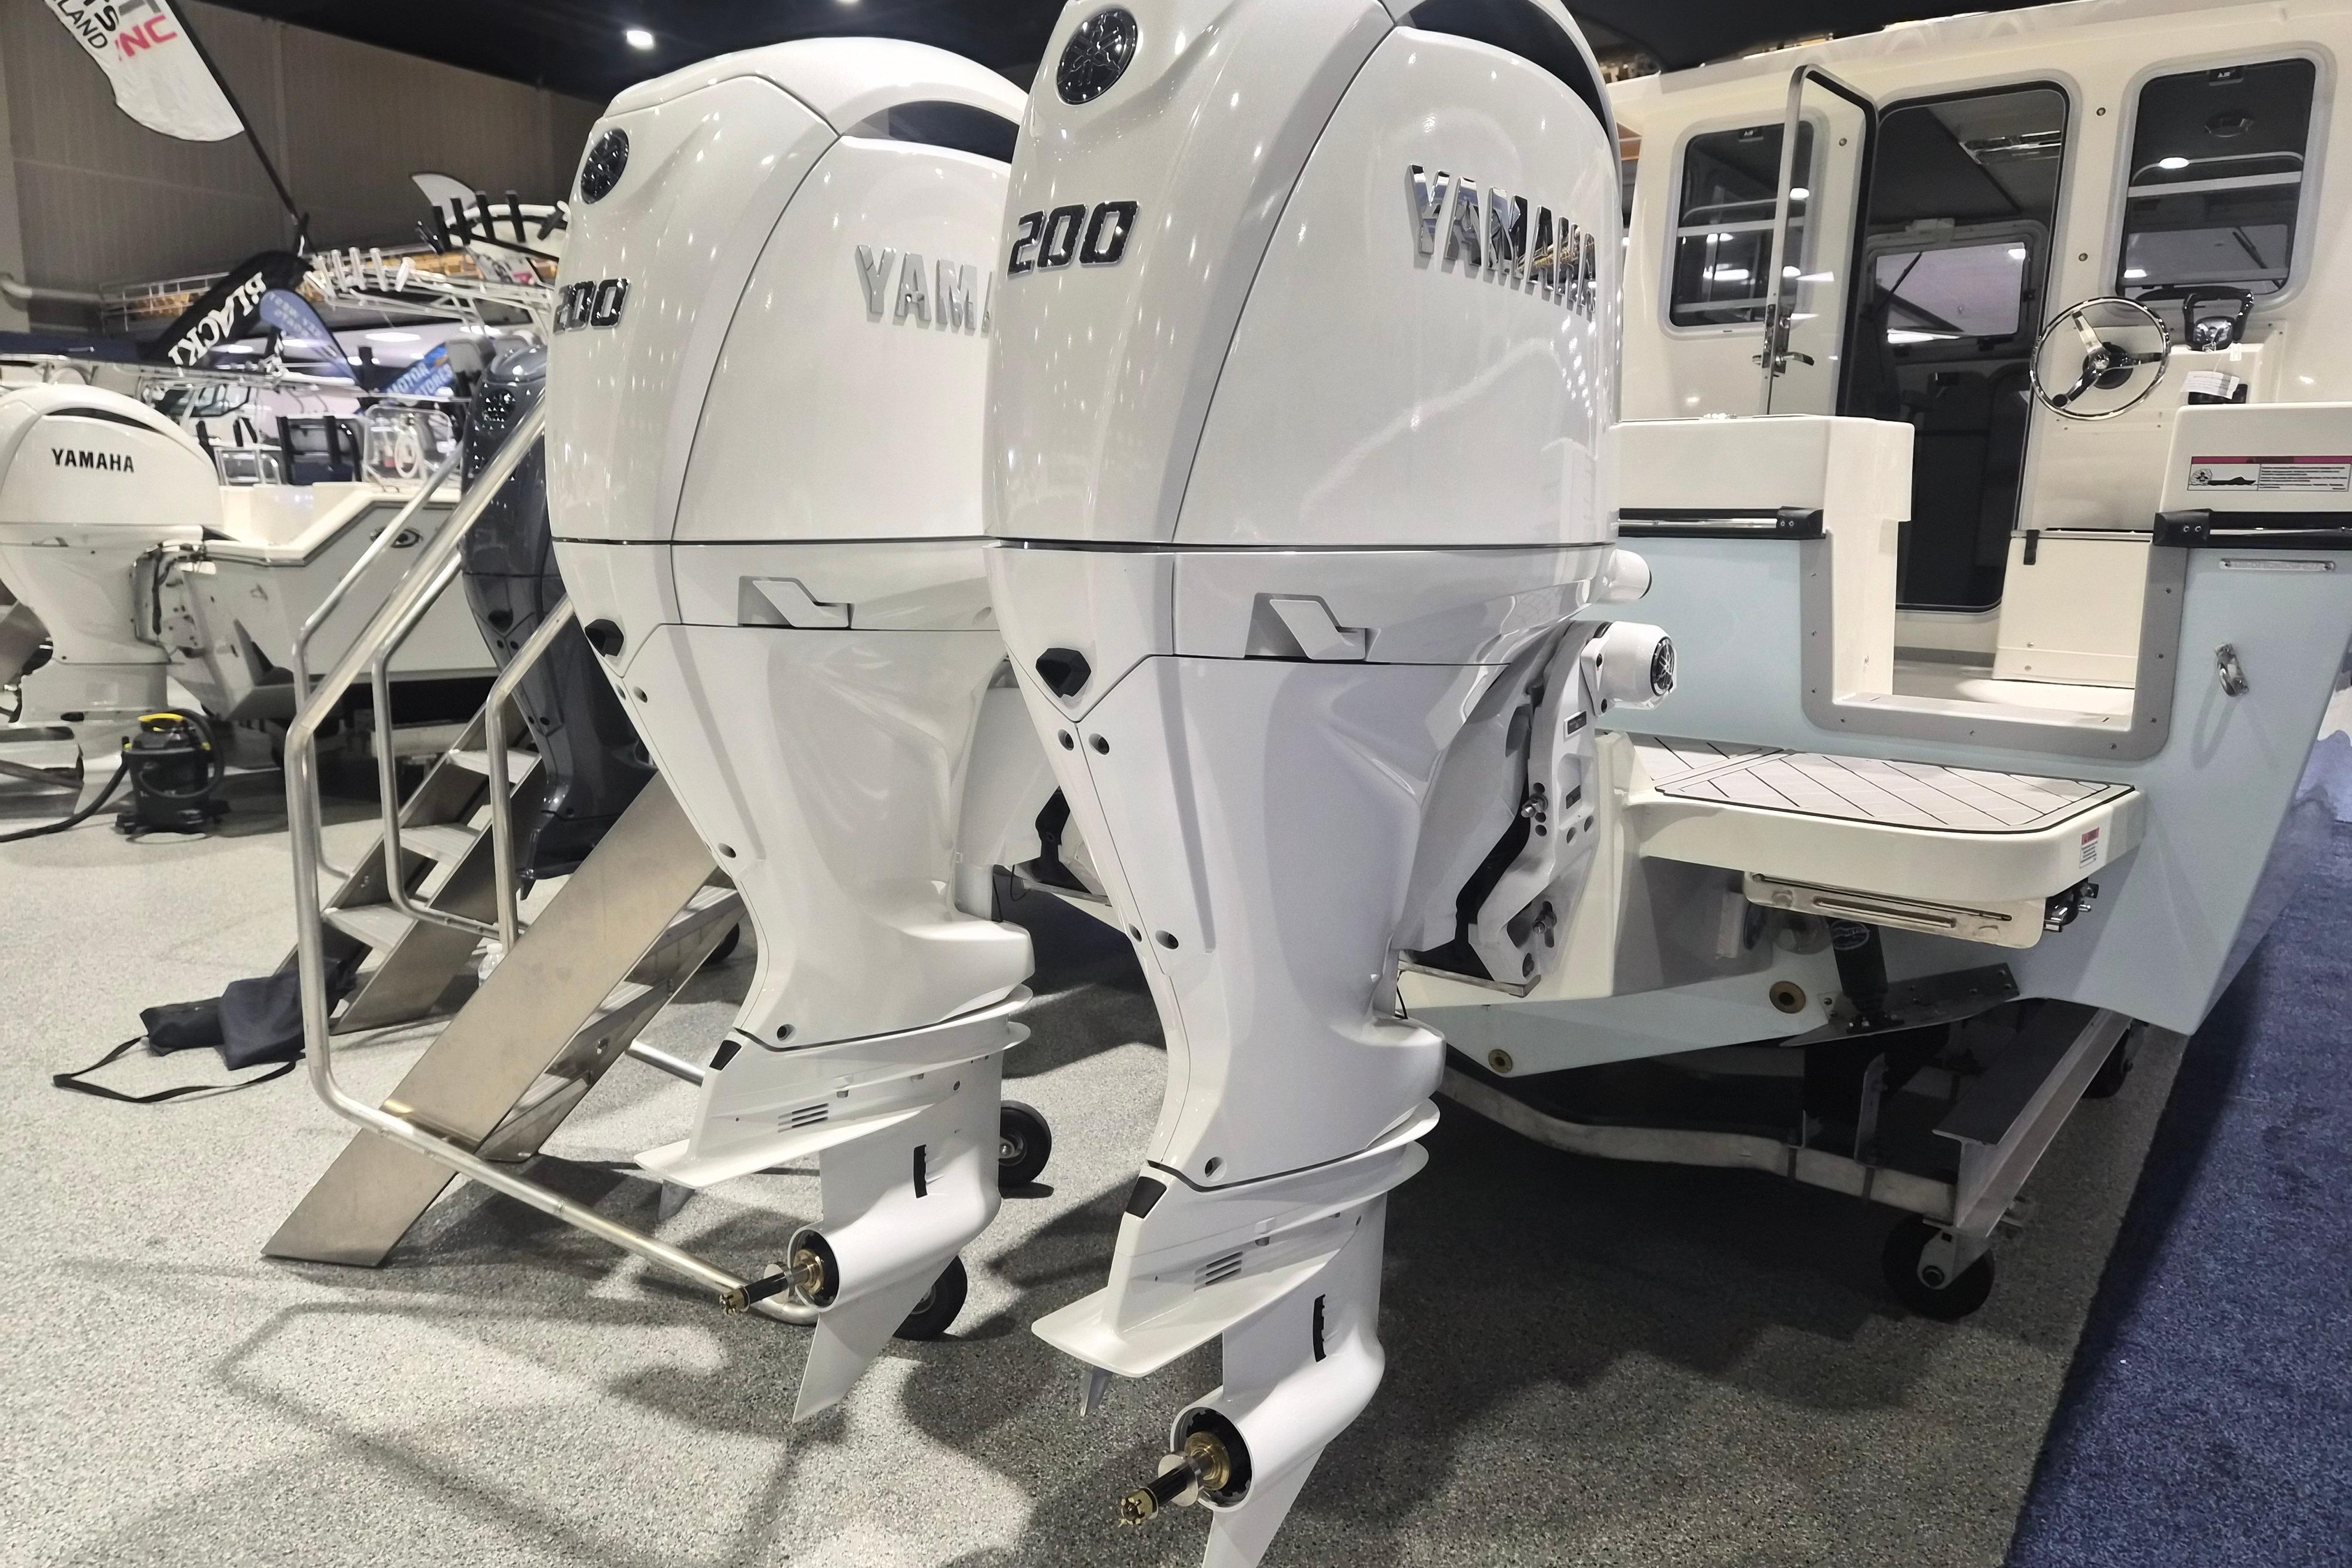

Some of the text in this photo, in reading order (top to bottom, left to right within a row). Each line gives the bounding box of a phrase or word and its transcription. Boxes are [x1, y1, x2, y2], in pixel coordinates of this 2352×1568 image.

[53, 0, 108, 48] LAND
[114, 15, 178, 61] NC
[1006, 200, 1140, 279] 200
[1405, 164, 1598, 314] YAMAHA
[854, 245, 993, 333] YAM
[52, 447, 134, 473] YAMAHA
